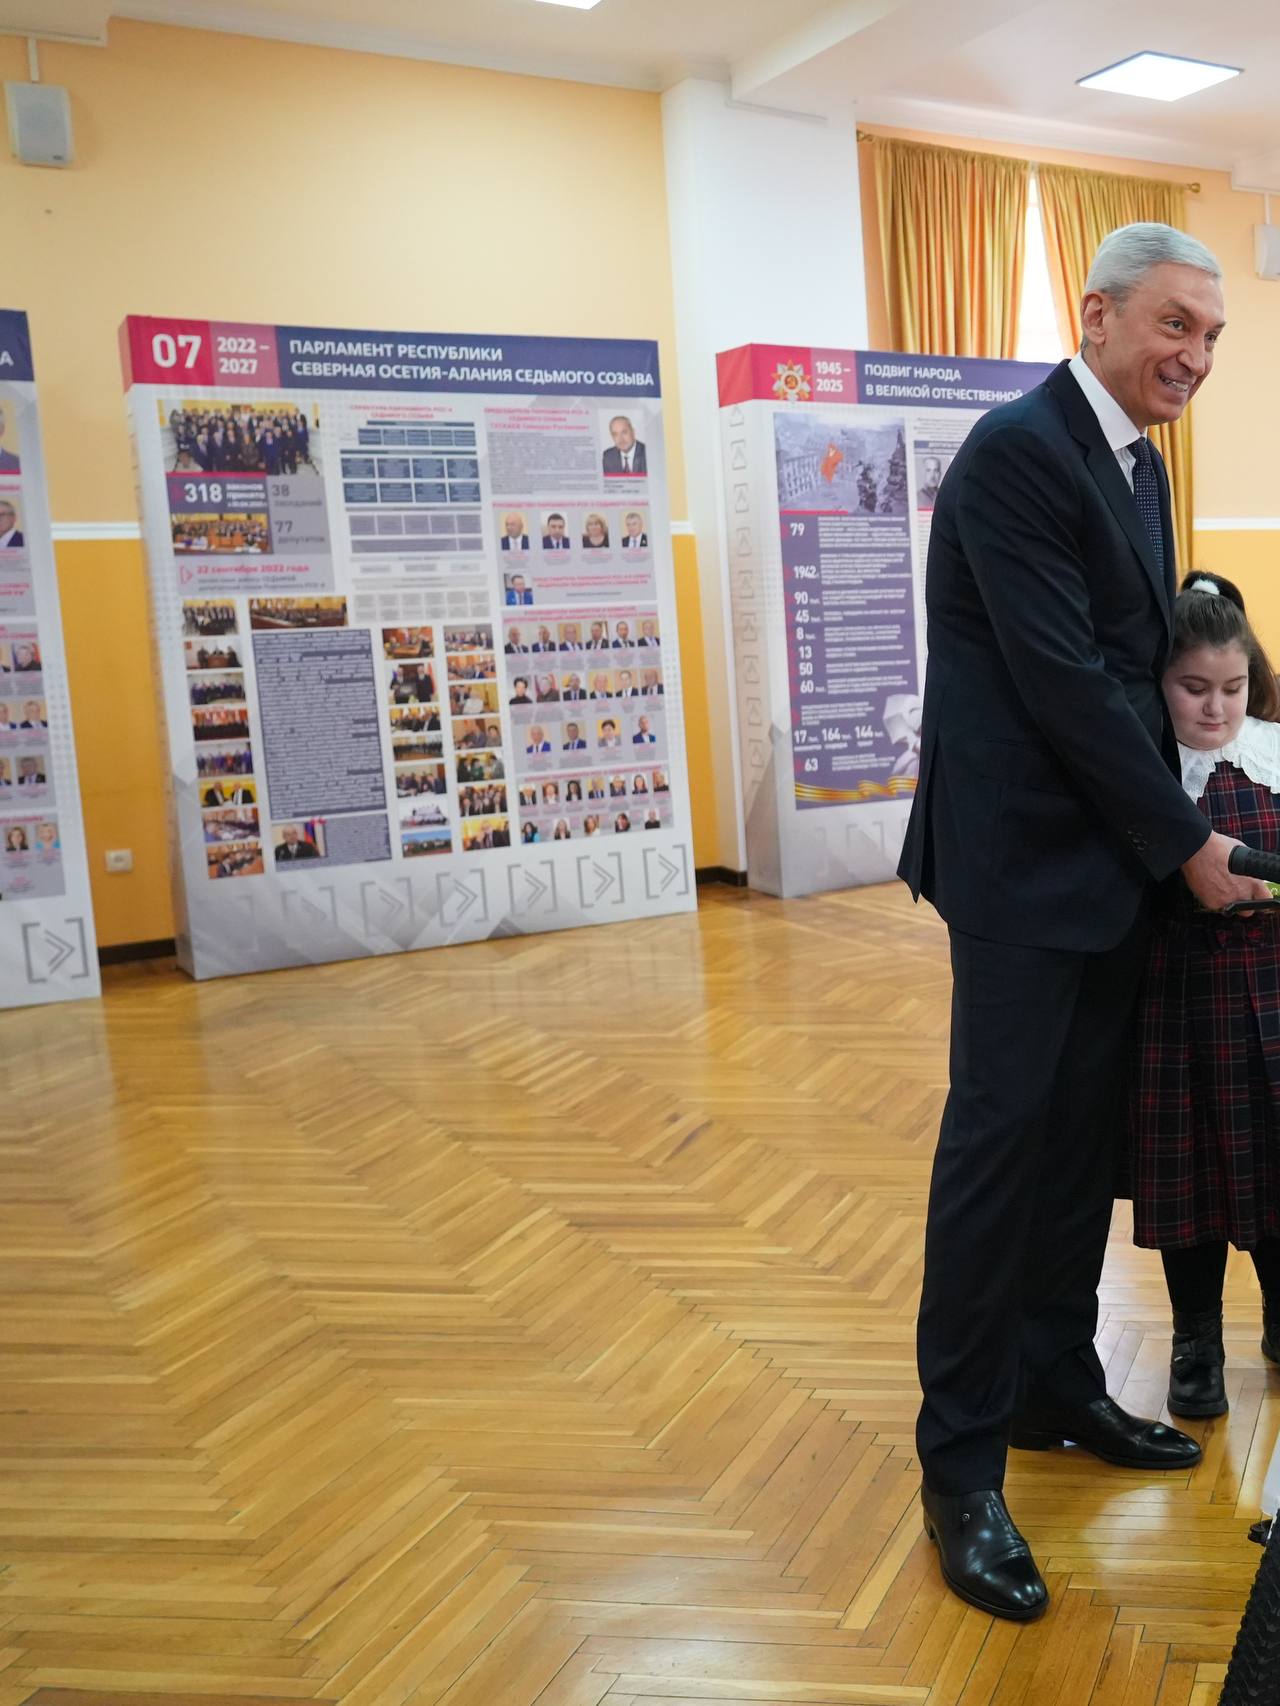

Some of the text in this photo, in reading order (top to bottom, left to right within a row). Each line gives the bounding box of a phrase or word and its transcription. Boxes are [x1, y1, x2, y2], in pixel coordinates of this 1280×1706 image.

[151, 333, 202, 369] 07
[217, 337, 257, 354] 2022
[289, 339, 503, 361] ПАРЛАМЕНТ РЕСПУБЛИКИ
[219, 358, 257, 375] 2027
[291, 361, 655, 387] СЕВЕРНАЯ ОСЕТИЯ-АЛАНИЯ СЕДЬМОГО СОЗЫВА
[815, 361, 842, 376] 1945
[864, 363, 962, 381] ПОДВИГ НАРОДА
[816, 378, 843, 393] 2025
[865, 384, 874, 396] В
[875, 383, 930, 399] ВЕЛИКОЙ
[184, 483, 223, 503] 318
[274, 520, 293, 533] 77
[790, 522, 805, 537] 79
[794, 591, 809, 605] 90
[796, 627, 804, 640] 8
[798, 646, 812, 659] 13
[799, 662, 813, 676] 50
[800, 680, 814, 693] 60
[804, 758, 819, 772] 63
